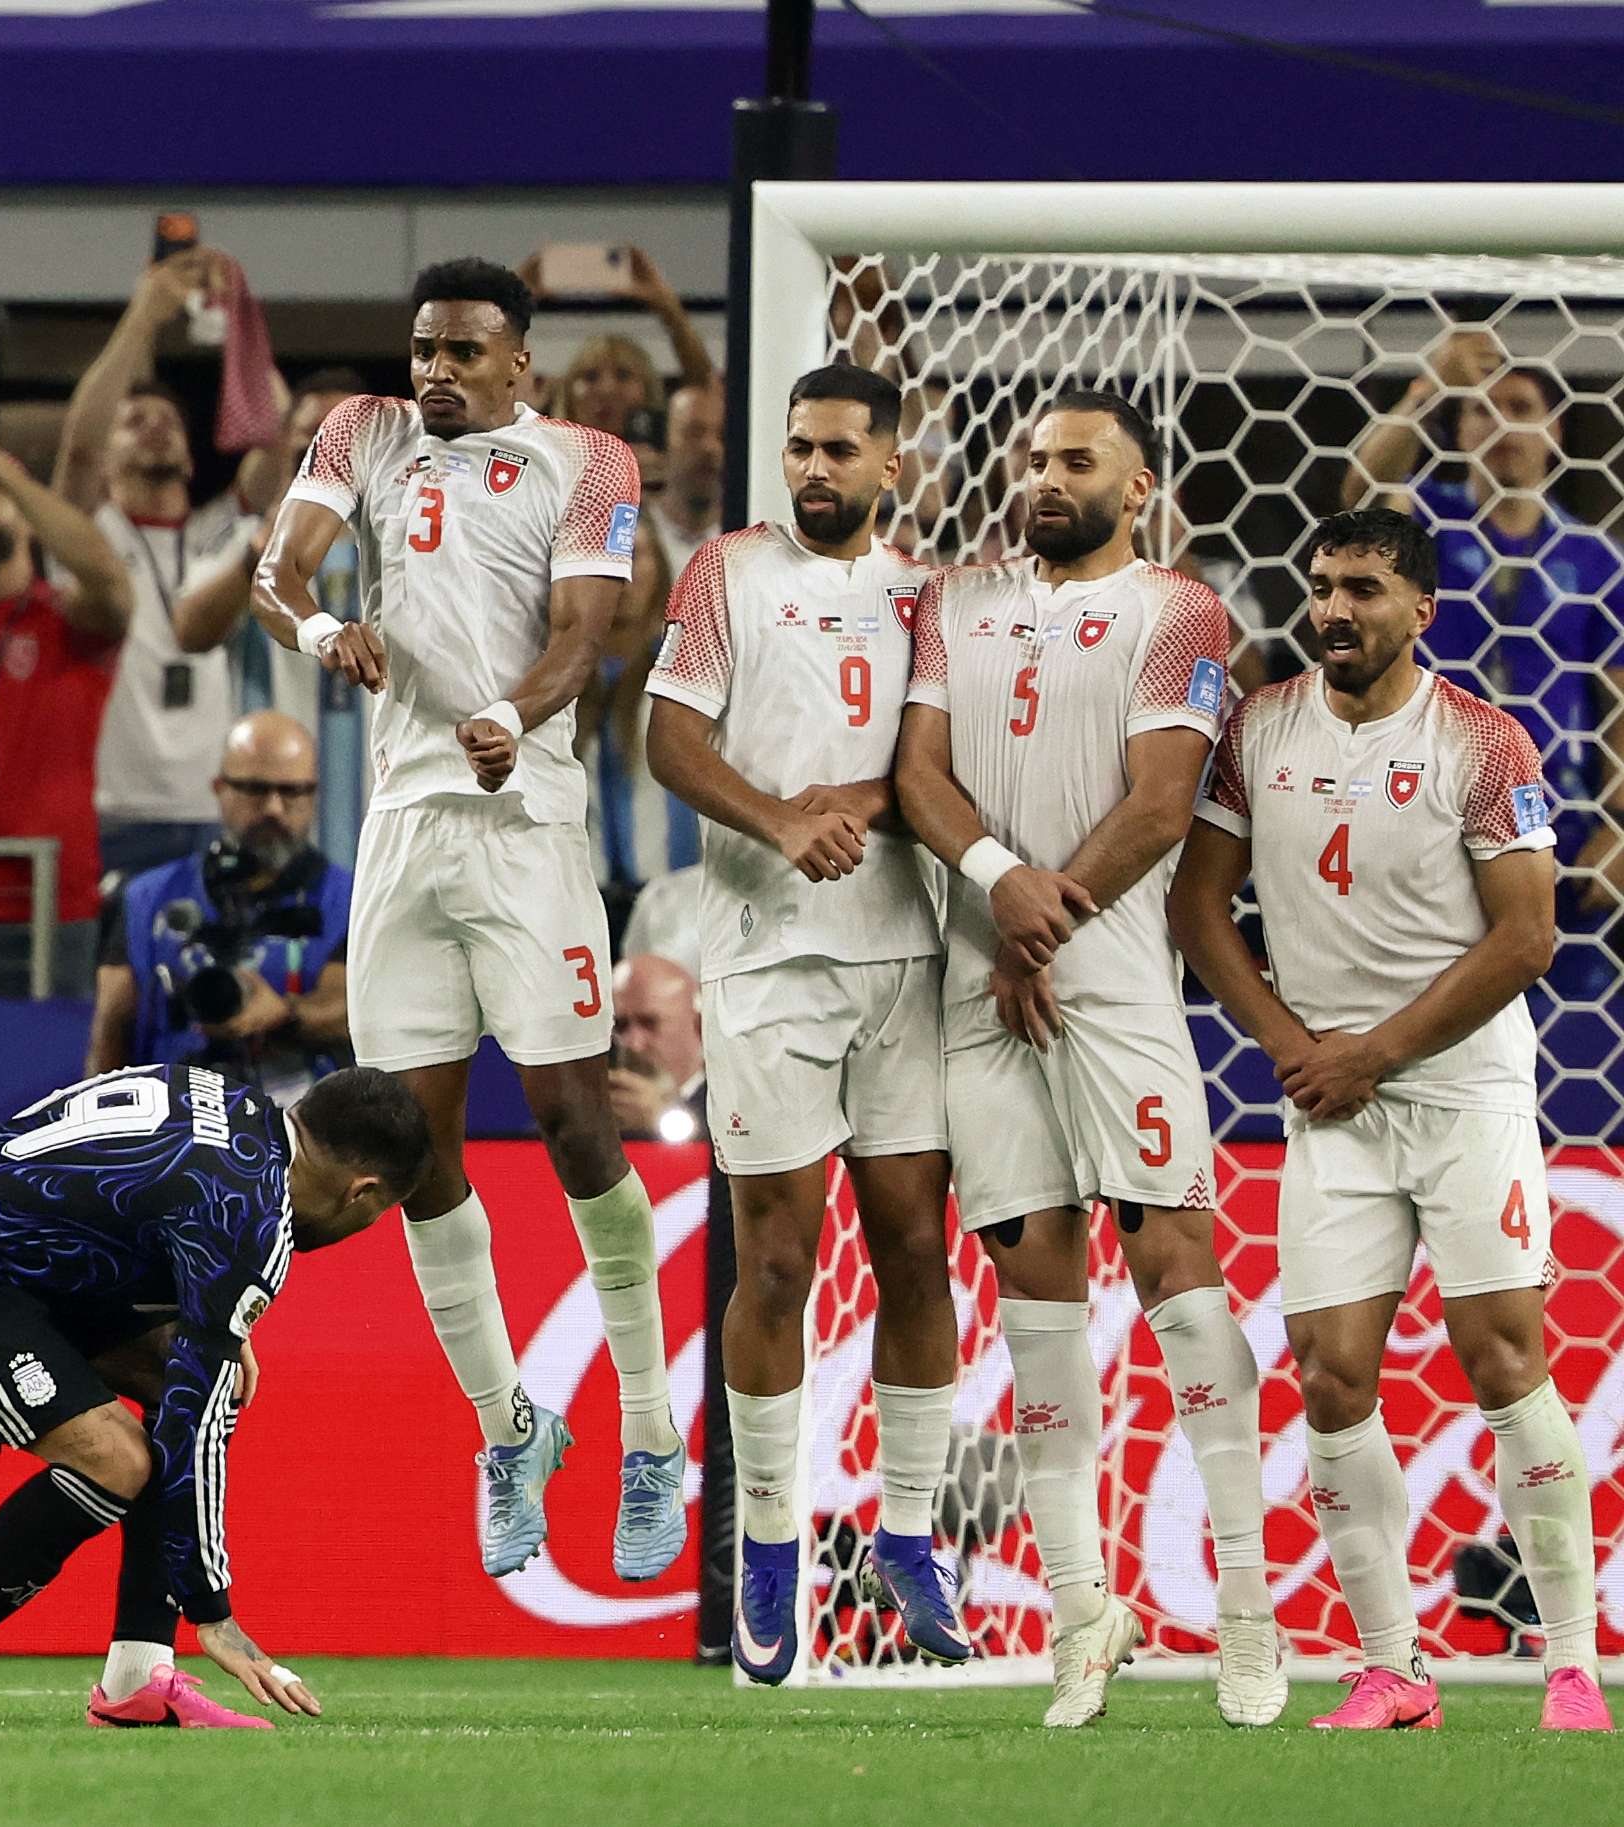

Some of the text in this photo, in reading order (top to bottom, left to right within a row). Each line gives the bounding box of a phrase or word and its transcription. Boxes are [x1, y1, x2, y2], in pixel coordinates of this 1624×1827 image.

[408, 487, 444, 552] 3
[776, 619, 808, 627] KELME
[839, 656, 871, 727] 9
[1009, 666, 1039, 736] 5
[1267, 782, 1295, 793] KELME
[1318, 823, 1353, 896] 4
[562, 944, 602, 1019] 3
[1136, 1096, 1172, 1168] 5
[1500, 1180, 1531, 1250] 4
[1178, 1397, 1228, 1417] KELME
